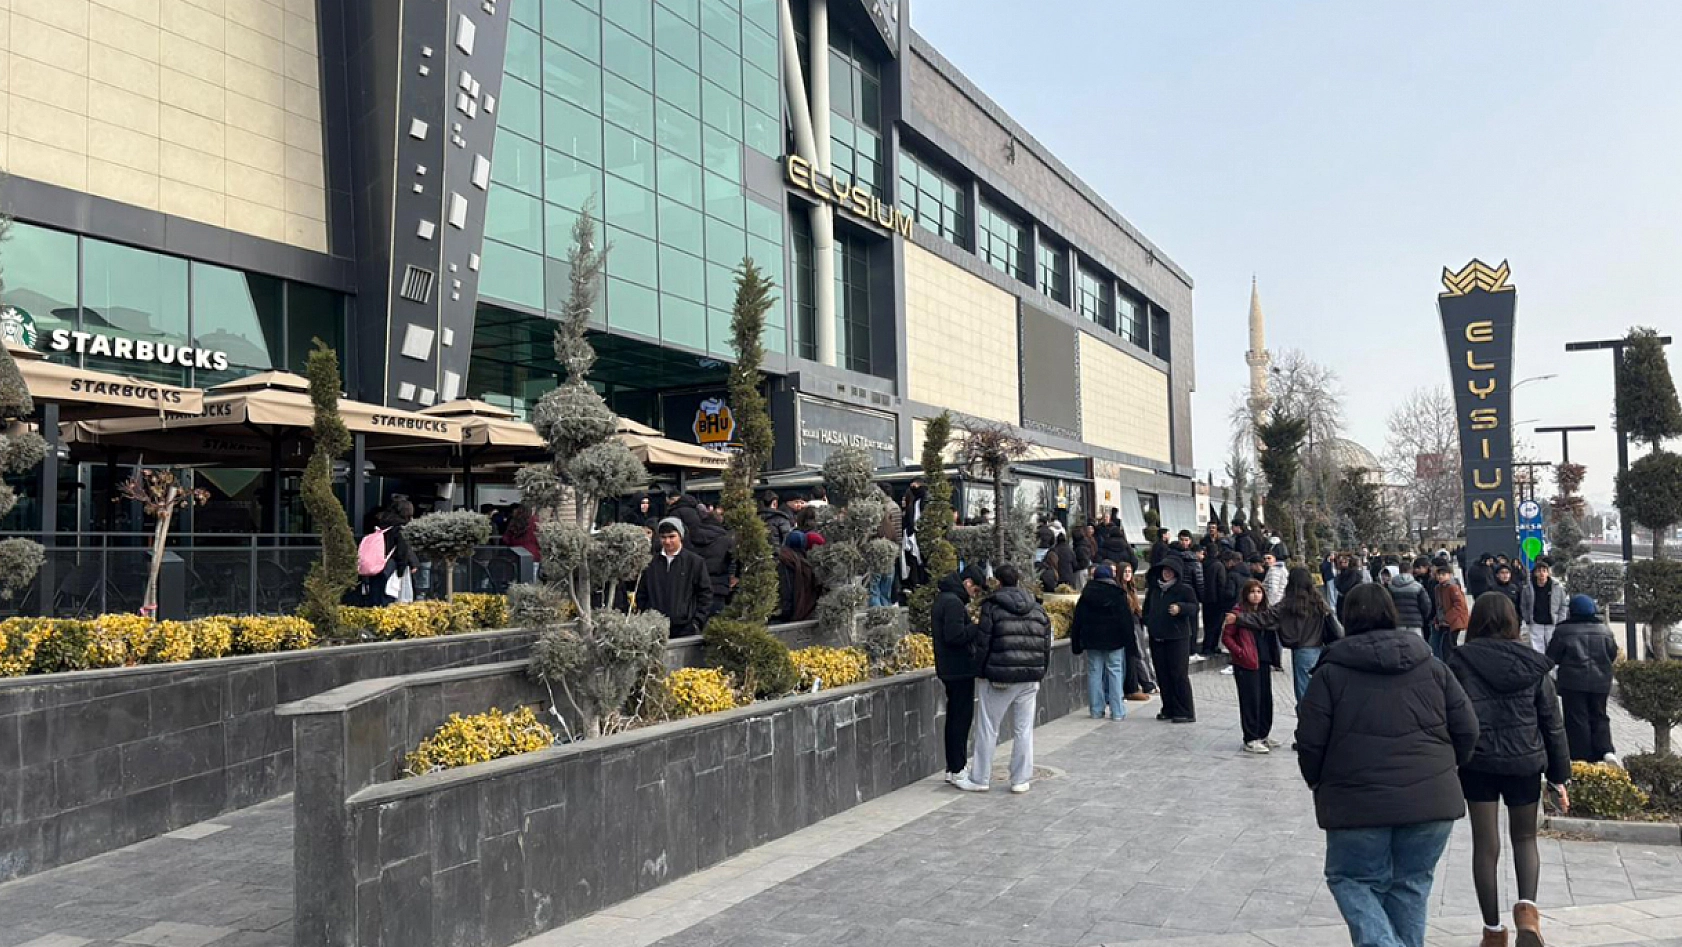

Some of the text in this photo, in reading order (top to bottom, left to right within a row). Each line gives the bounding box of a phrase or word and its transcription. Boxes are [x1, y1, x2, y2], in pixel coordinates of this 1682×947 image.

[787, 154, 914, 240] ELYSIUM
[51, 329, 229, 371] STARBUCKS
[70, 378, 182, 404] STARBUCKS
[371, 413, 448, 434] STARBUCKS
[1464, 319, 1507, 520] ELYSIUM
